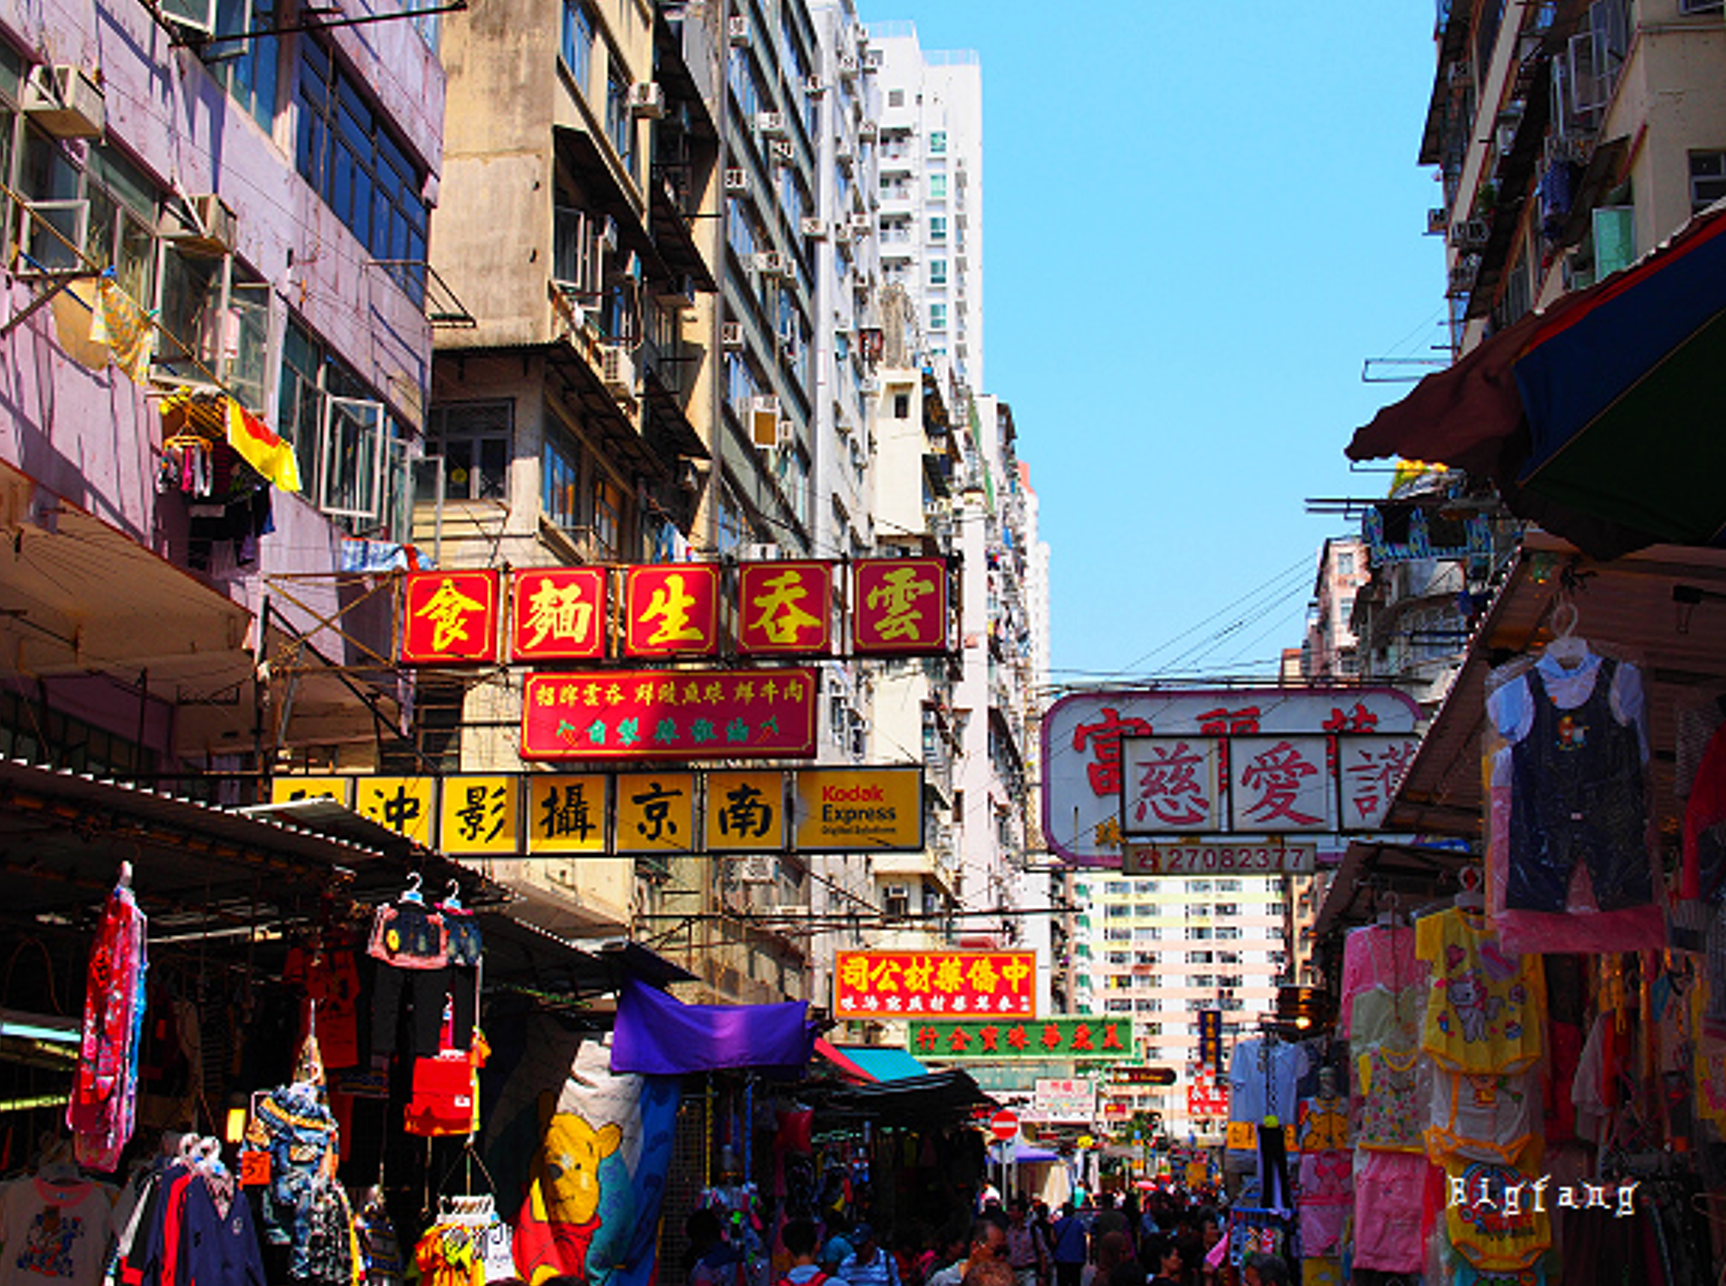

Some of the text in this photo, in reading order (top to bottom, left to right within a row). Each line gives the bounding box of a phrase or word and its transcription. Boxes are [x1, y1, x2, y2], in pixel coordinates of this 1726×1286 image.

[822, 783, 884, 802] Kodak
[822, 803, 896, 824] Express
[1166, 848, 1305, 869] 27082377
